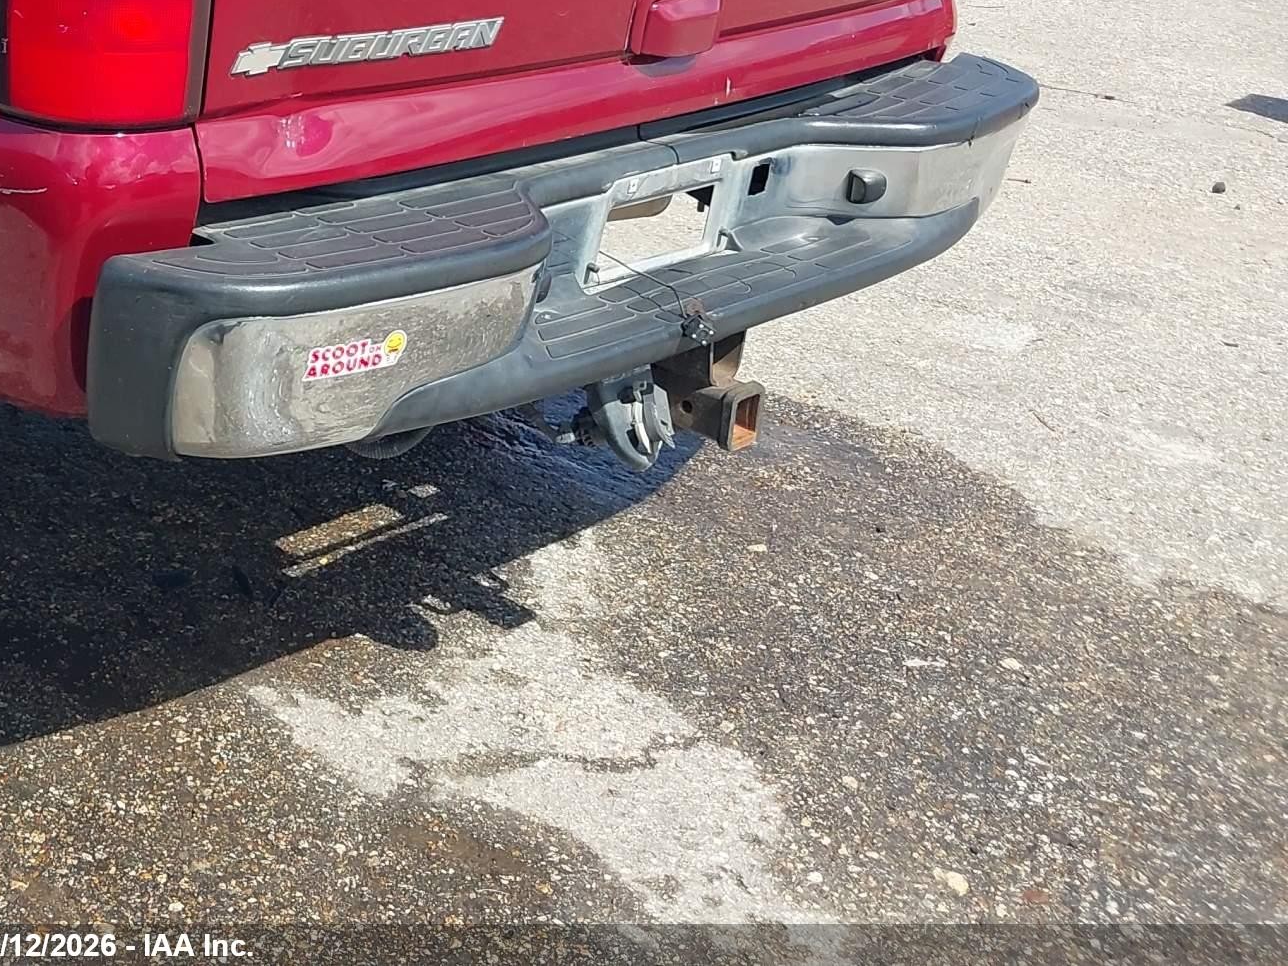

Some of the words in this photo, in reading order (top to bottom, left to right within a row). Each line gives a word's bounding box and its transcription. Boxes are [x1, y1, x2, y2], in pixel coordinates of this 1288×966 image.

[276, 16, 504, 70] SUBURBAN
[311, 341, 368, 363] SCOOT
[307, 354, 382, 378] AROUND
